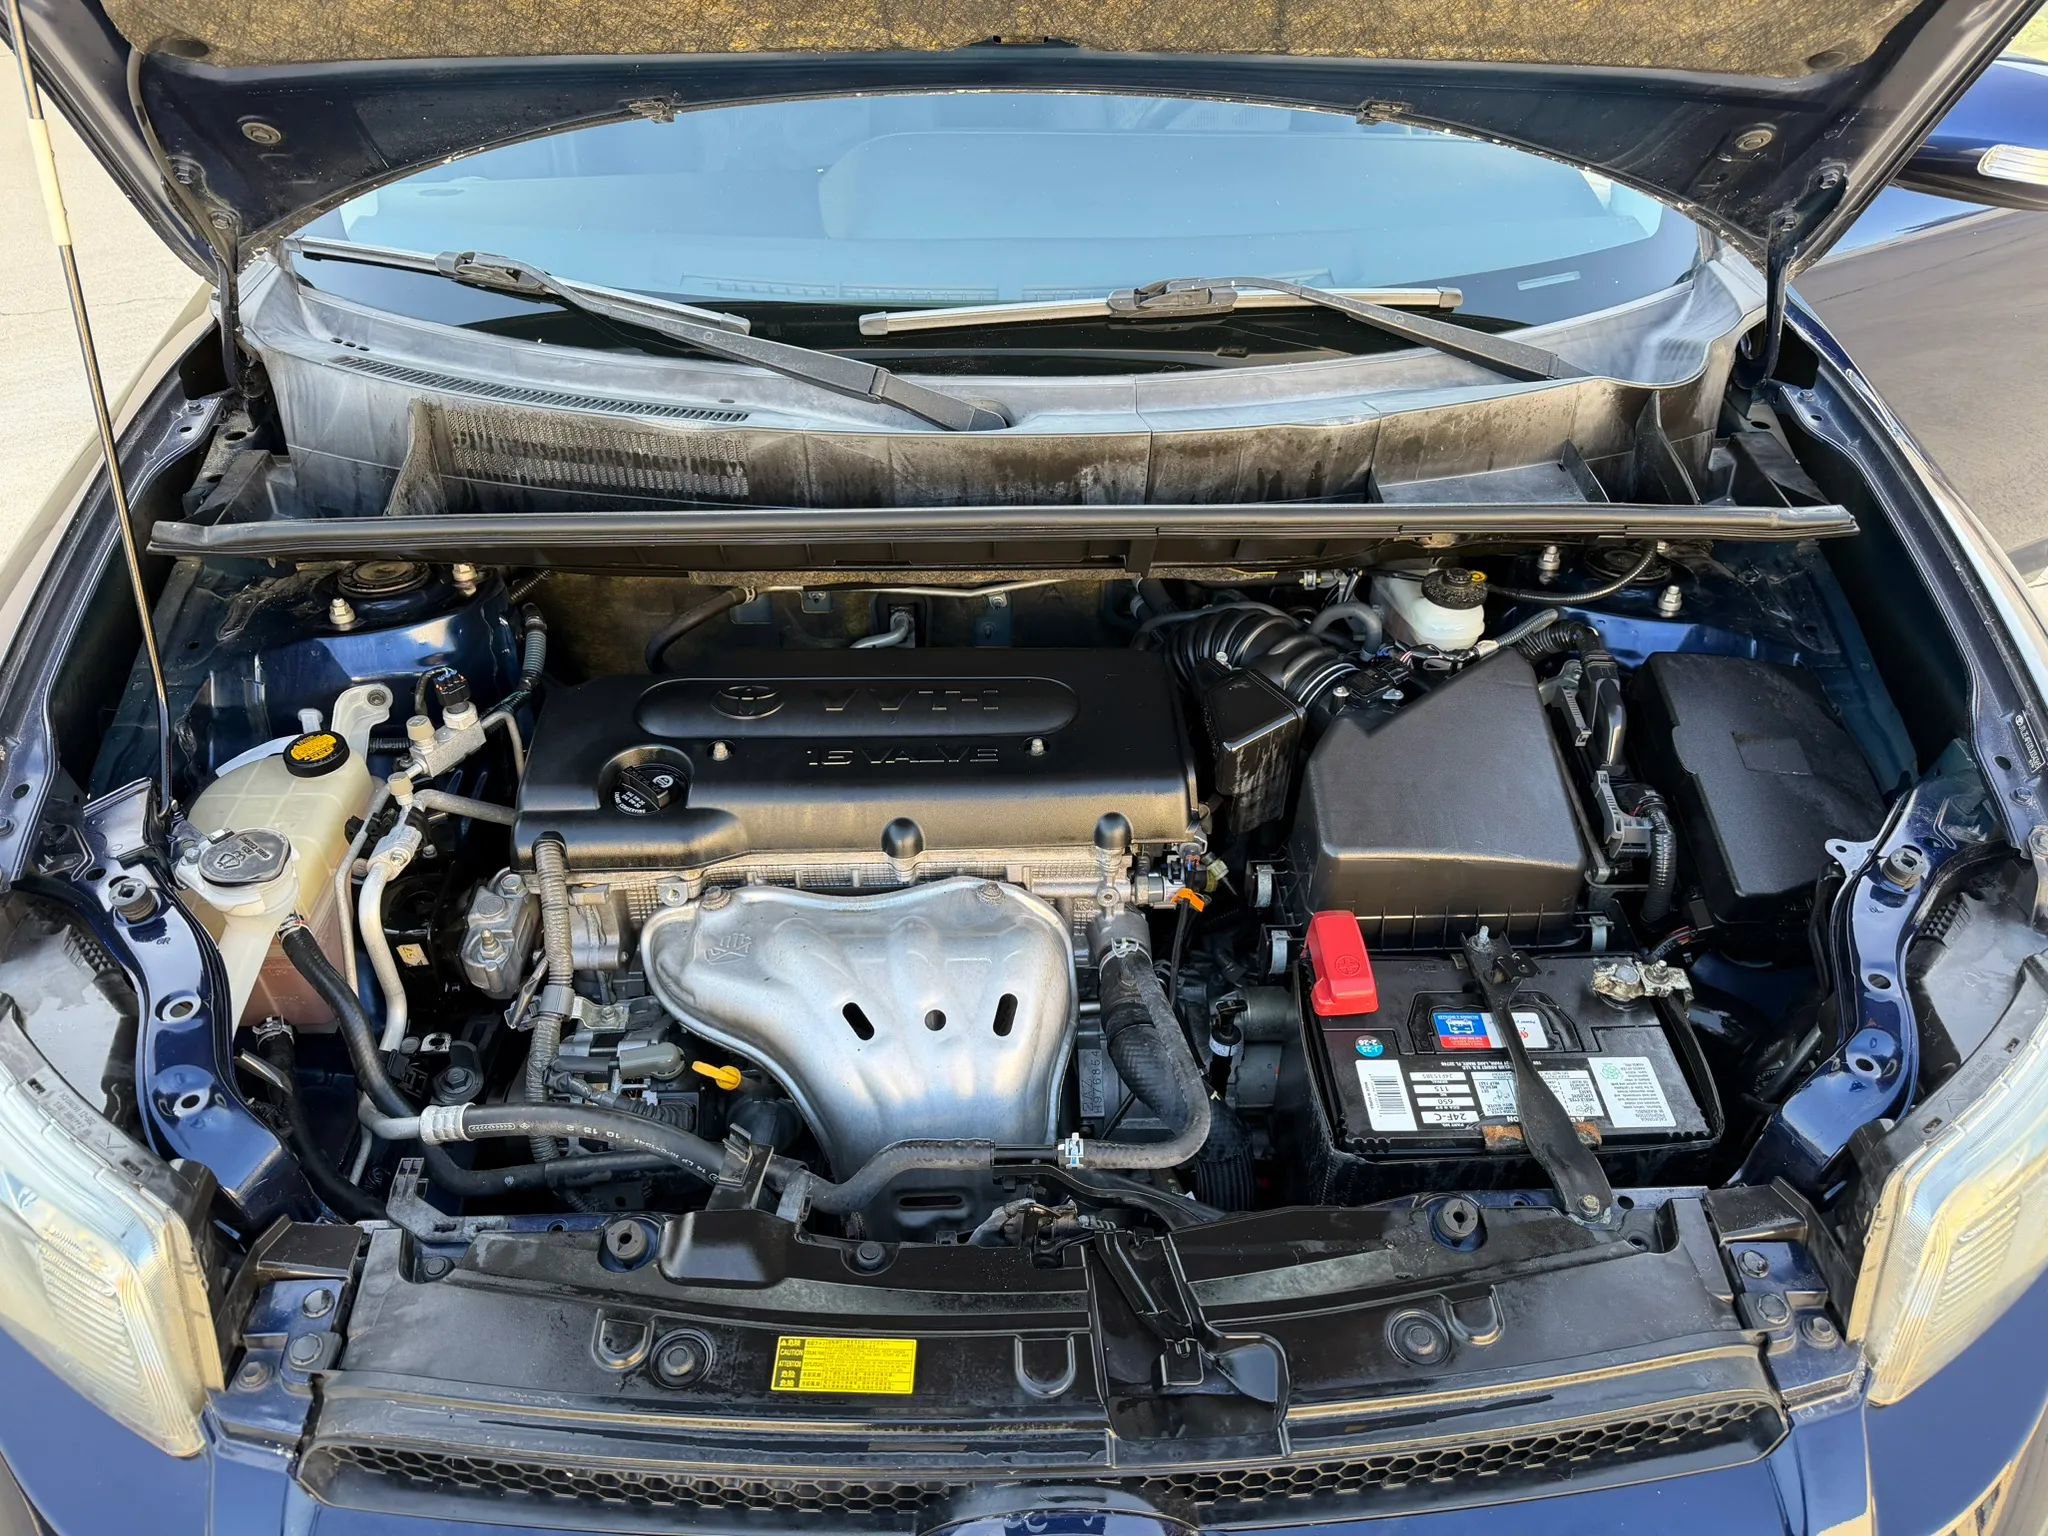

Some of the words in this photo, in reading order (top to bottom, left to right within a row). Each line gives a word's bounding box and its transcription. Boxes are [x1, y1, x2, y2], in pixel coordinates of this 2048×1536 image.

[808, 748, 853, 766] 16
[861, 747, 1000, 766] VALVE
[1081, 1078, 1093, 1111] 2AZ
[1434, 1113, 1466, 1121] 24F-C
